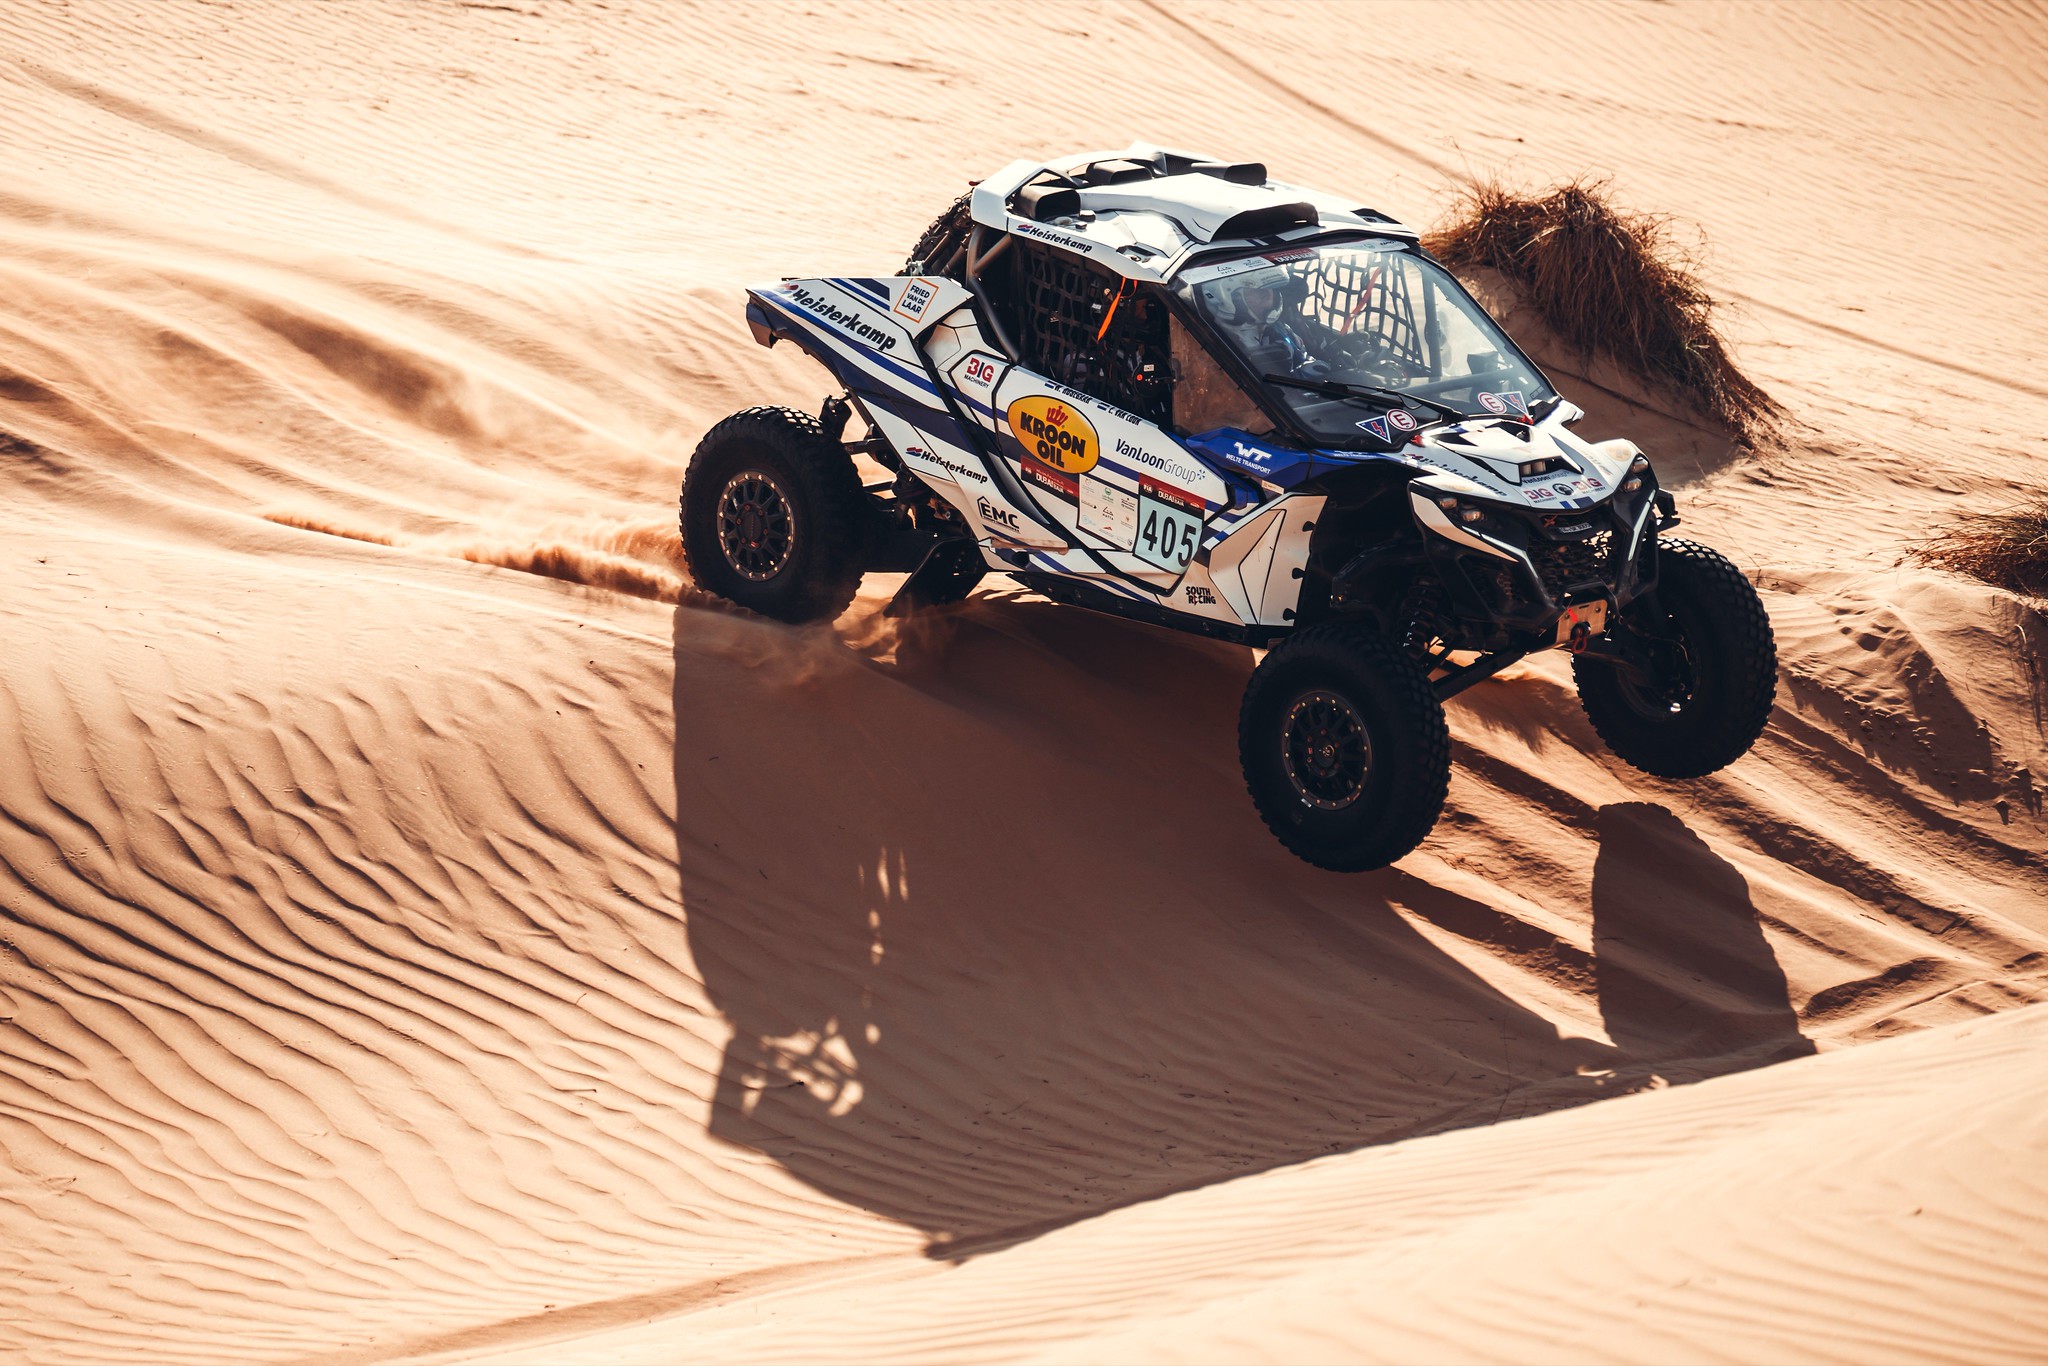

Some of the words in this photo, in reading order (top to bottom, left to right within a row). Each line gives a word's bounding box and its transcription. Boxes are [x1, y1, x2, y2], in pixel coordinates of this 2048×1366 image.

[1029, 227, 1093, 253] Heisterkamp
[907, 293, 918, 303] VAN
[917, 298, 926, 306] DE
[910, 285, 930, 298] FRIED
[793, 288, 897, 351] Heisterkamp
[902, 300, 922, 314] LAAR
[964, 374, 989, 388] MACHINERY
[1020, 411, 1086, 458] KROON
[1036, 441, 1065, 469] OIL
[1115, 438, 1197, 484] VanLoonGroup
[1226, 453, 1242, 464] WELTE
[1241, 459, 1271, 475] TRANSPORT
[1233, 441, 1272, 462] WT
[921, 451, 988, 484] Heisterkamp
[980, 502, 1020, 529] EMC
[1142, 509, 1197, 568] 405
[1185, 586, 1211, 596] SOUTH
